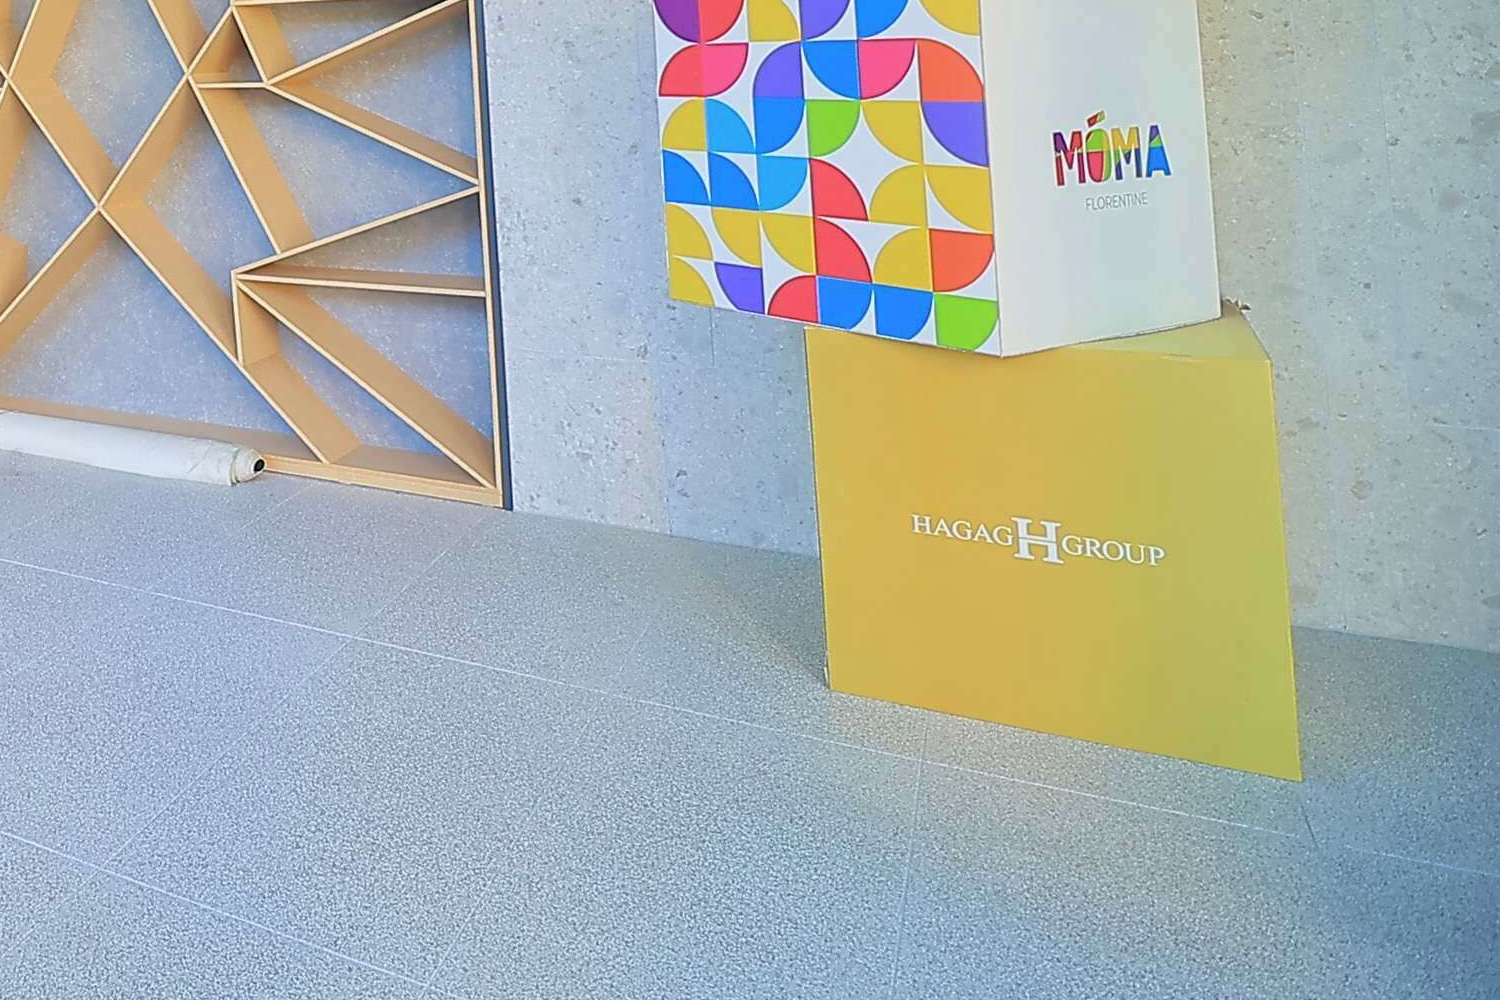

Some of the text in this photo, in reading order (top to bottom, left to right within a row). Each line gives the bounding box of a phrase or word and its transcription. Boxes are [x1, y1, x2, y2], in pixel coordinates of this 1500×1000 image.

[1085, 192, 1148, 211] FLORENTINE
[911, 514, 1014, 547] HAGAG
[1061, 535, 1166, 567] GROUP
